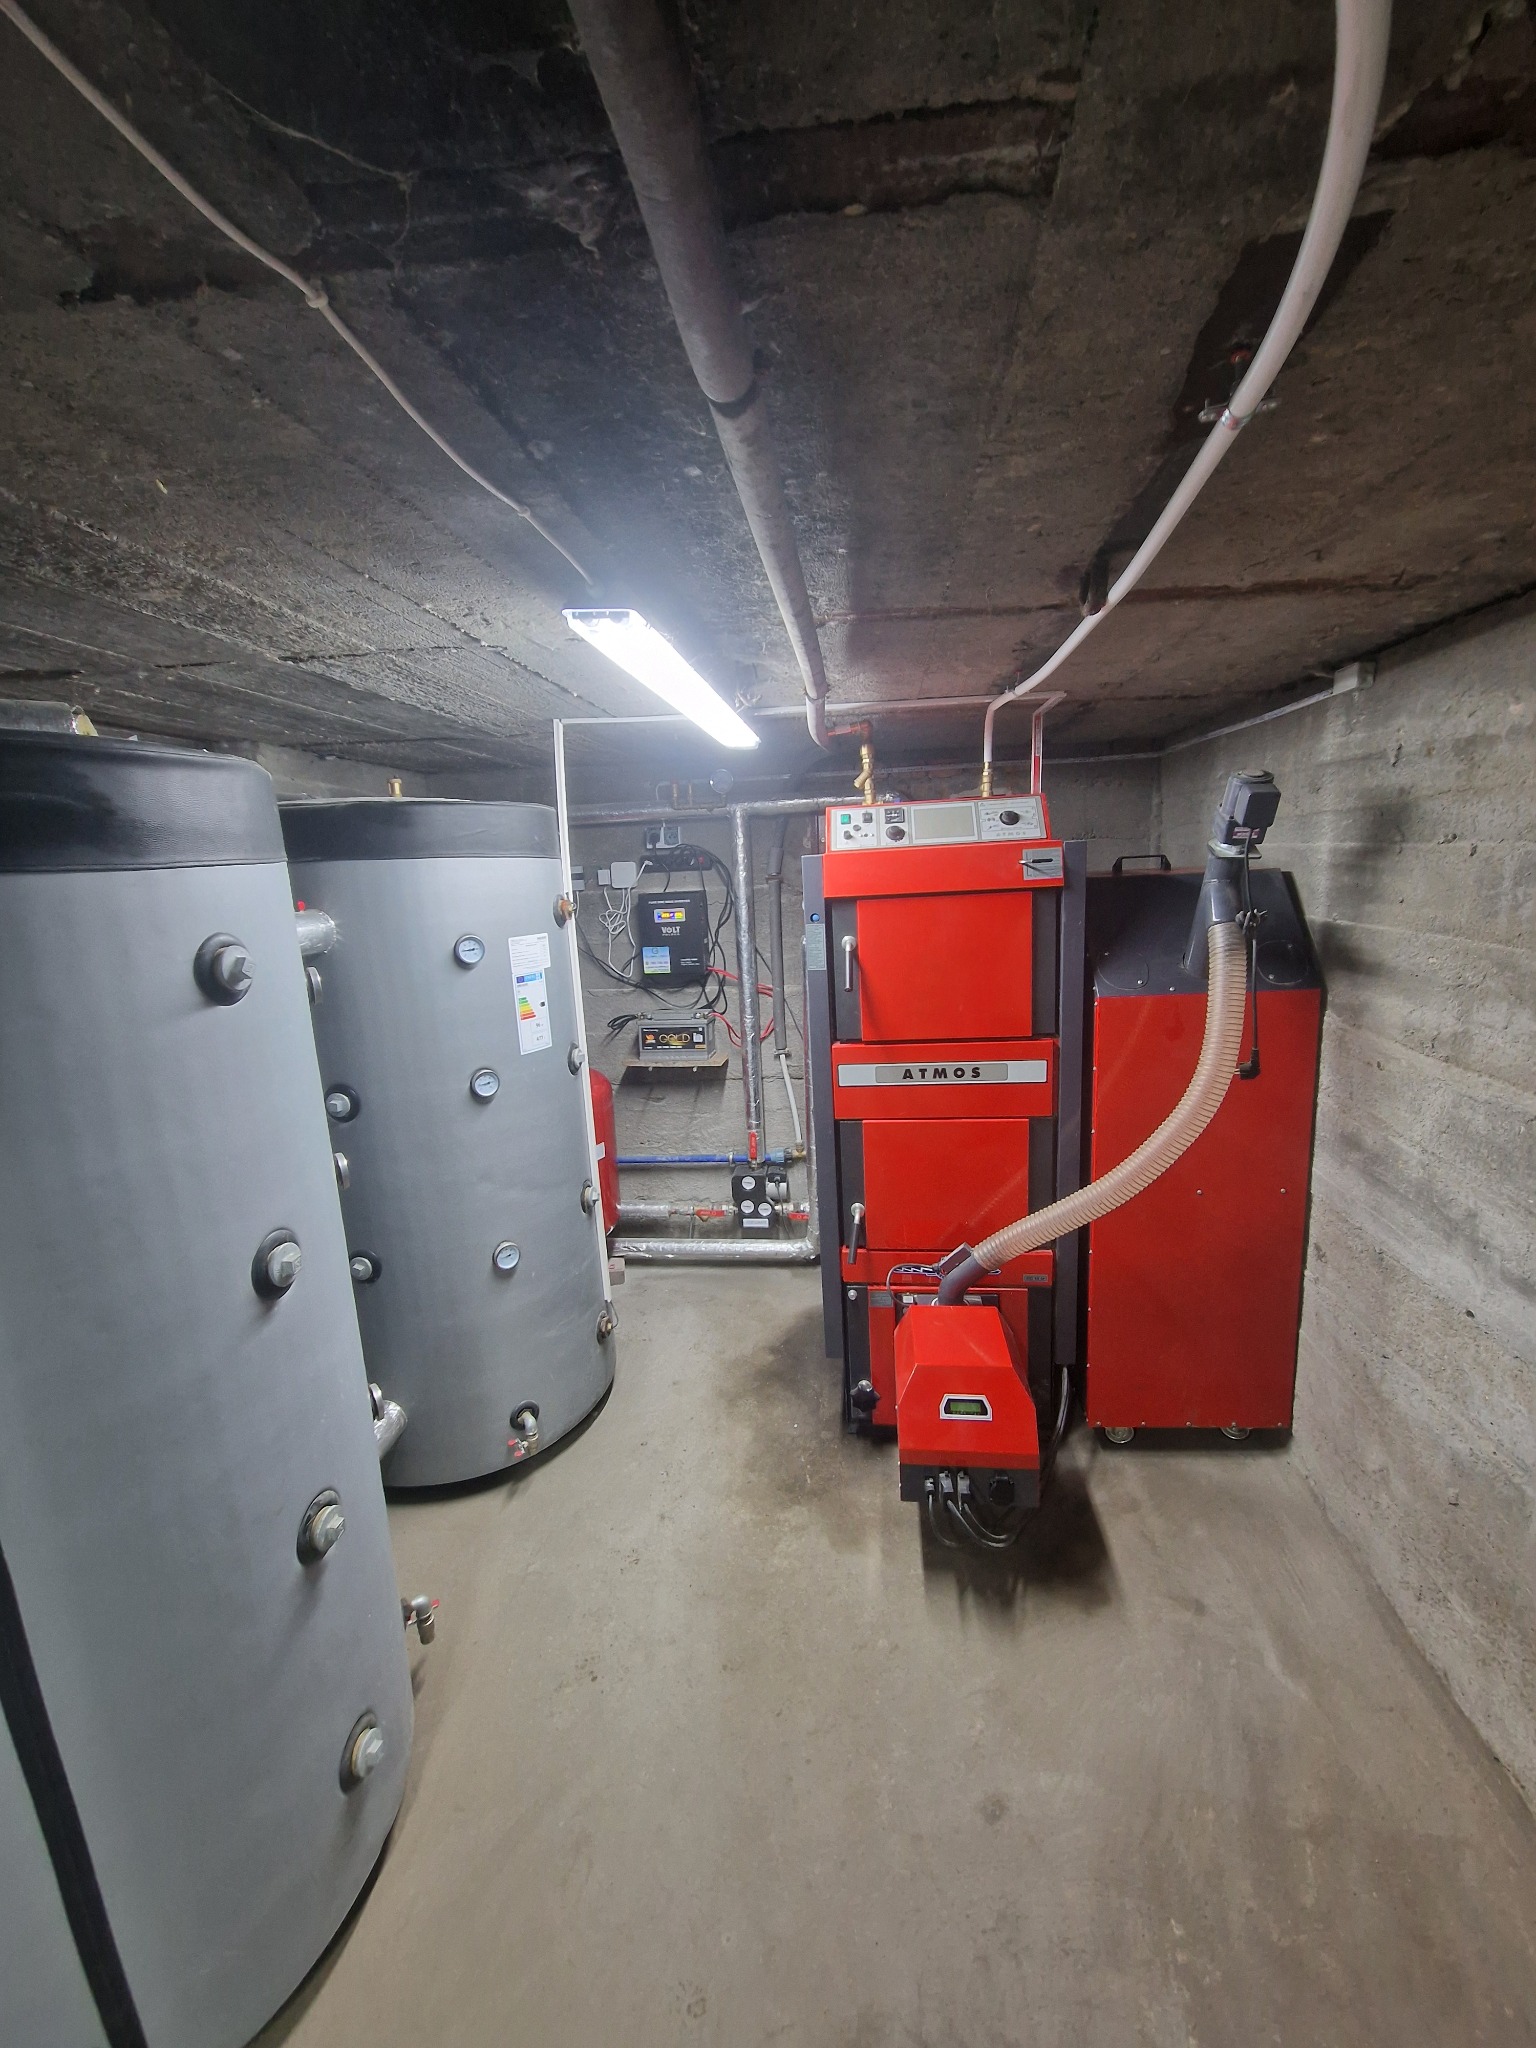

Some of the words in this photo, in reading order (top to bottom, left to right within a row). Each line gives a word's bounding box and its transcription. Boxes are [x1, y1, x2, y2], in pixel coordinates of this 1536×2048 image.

[661, 926, 680, 934] VOLT
[659, 1033, 690, 1043] GOLD
[902, 1067, 981, 1080] ATMOS
